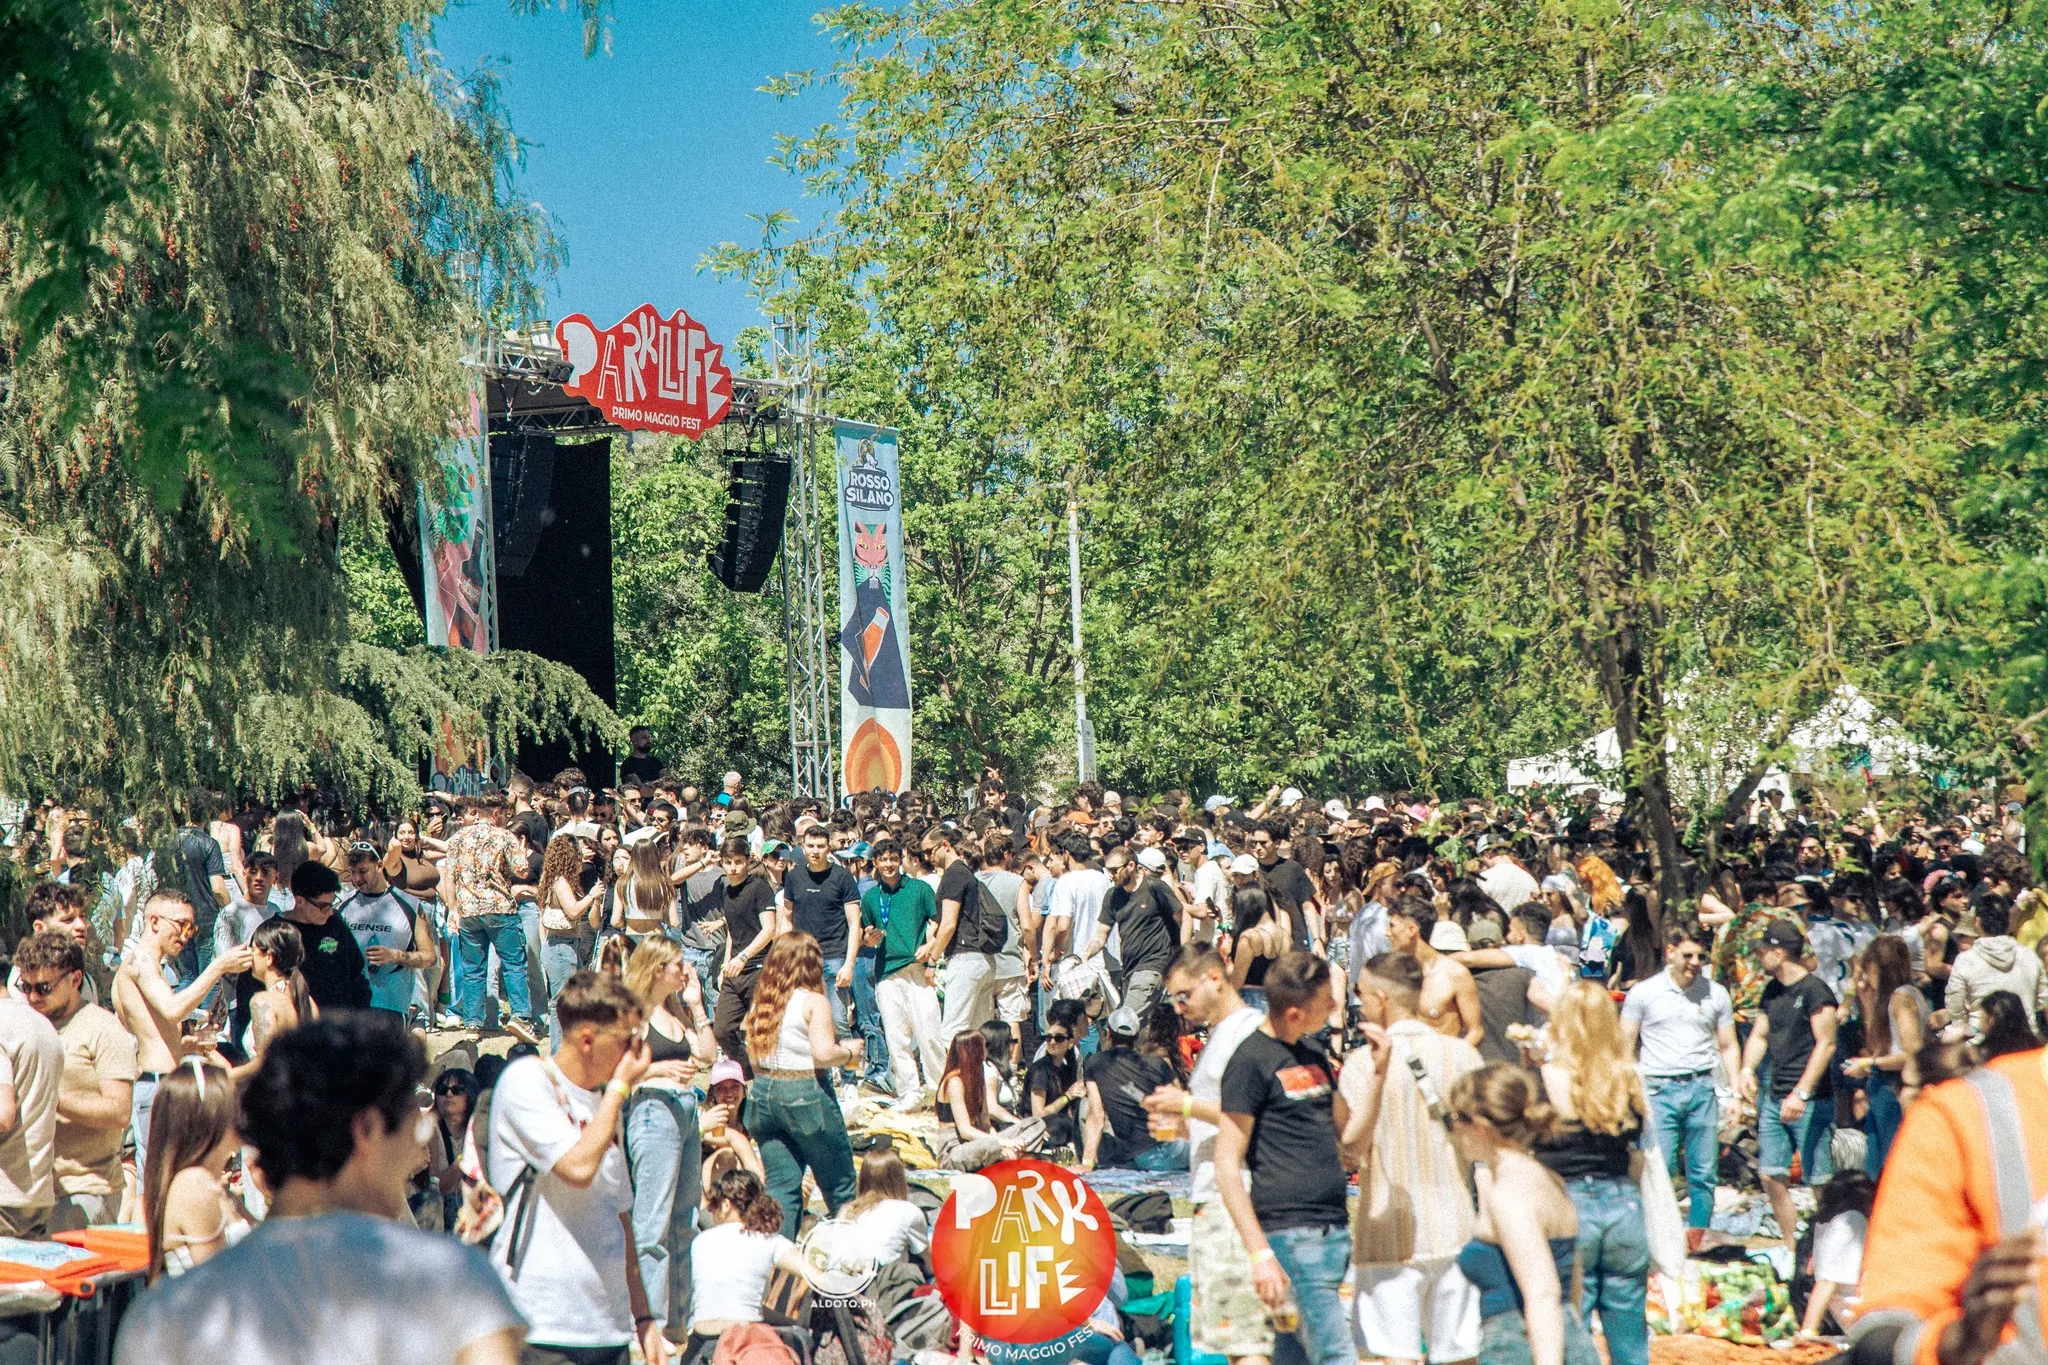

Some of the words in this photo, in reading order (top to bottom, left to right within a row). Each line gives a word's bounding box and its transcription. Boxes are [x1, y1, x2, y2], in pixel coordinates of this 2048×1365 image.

[562, 311, 729, 421] PARKLIFE
[612, 405, 642, 422] PRIMO
[644, 411, 680, 427] MAGGIO
[681, 416, 701, 430] FEST
[850, 471, 890, 491] ROSSO
[845, 487, 894, 507] SILANO
